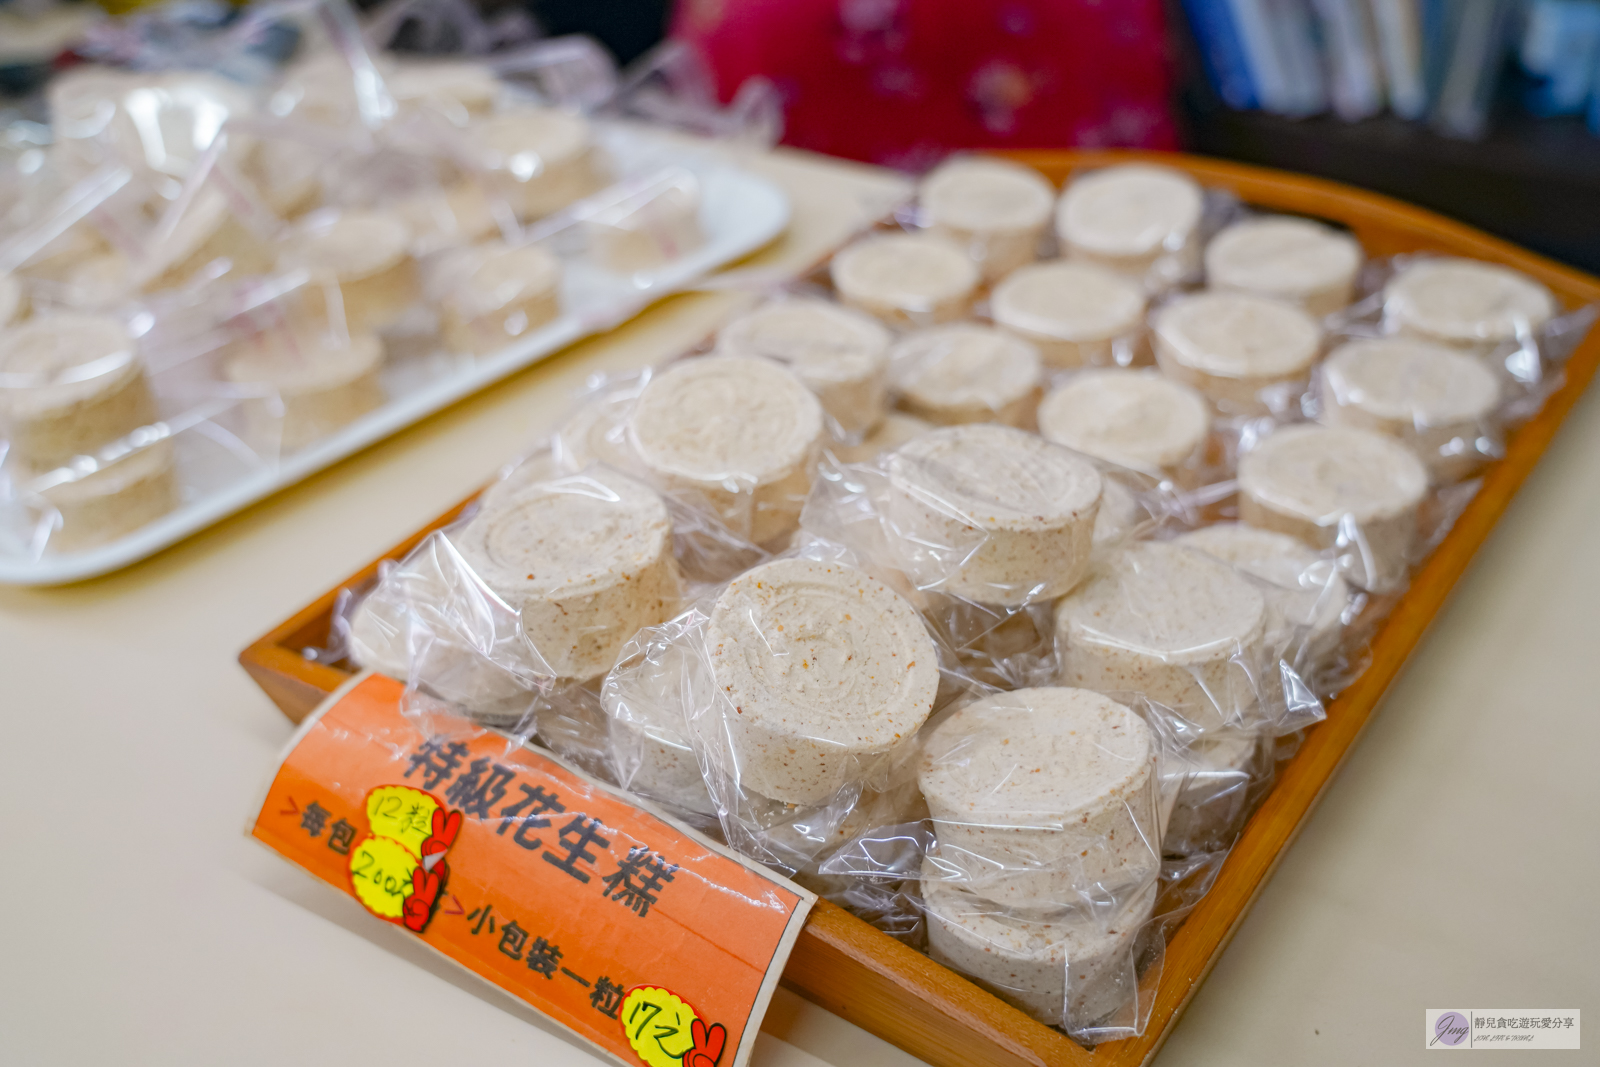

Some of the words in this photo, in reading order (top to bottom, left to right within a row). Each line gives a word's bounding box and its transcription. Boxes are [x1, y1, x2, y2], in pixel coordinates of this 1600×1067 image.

[301, 800, 357, 856] 每包
[403, 735, 678, 918] 特級花生糕
[467, 904, 625, 1020] 小包裝一粒
